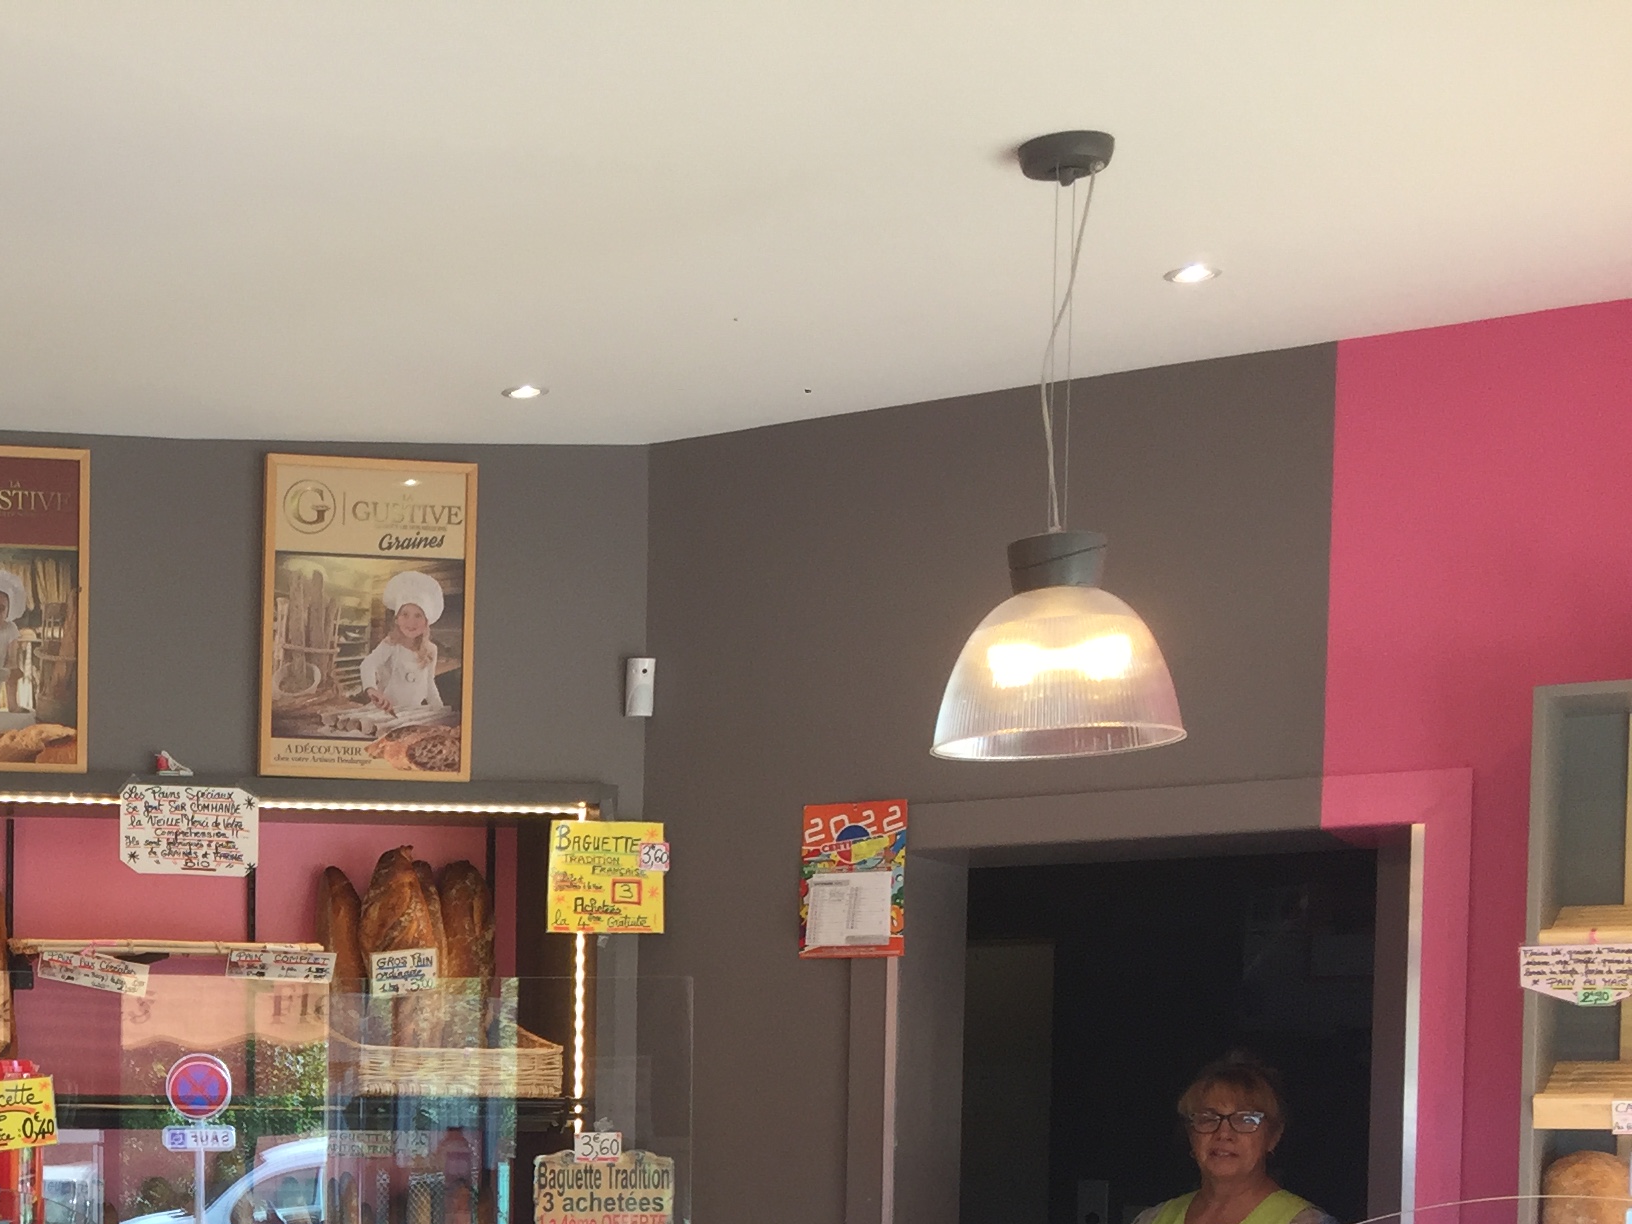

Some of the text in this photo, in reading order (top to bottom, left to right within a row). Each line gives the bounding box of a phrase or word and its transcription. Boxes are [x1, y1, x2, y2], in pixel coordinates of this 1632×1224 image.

[352, 500, 463, 526] GUSTIVE
[378, 532, 446, 551] Graines
[285, 742, 362, 757] A DÉCOUVRIR
[123, 786, 234, 803] Les Pains Spéciaux
[190, 803, 241, 814] COMMANDE
[804, 805, 905, 844] 2022
[555, 824, 641, 853] BAGUETTE
[563, 854, 621, 865] TRADITION
[591, 865, 648, 877] FRANÇAISE
[619, 883, 634, 899] 3
[552, 909, 569, 926] la
[236, 952, 331, 965] PAIN COMPLET
[376, 952, 433, 968] GROS PAIN
[1546, 978, 1576, 986] PAIN
[538, 1162, 670, 1197] Baguette Tradition
[542, 1191, 665, 1213] 3 achetées
